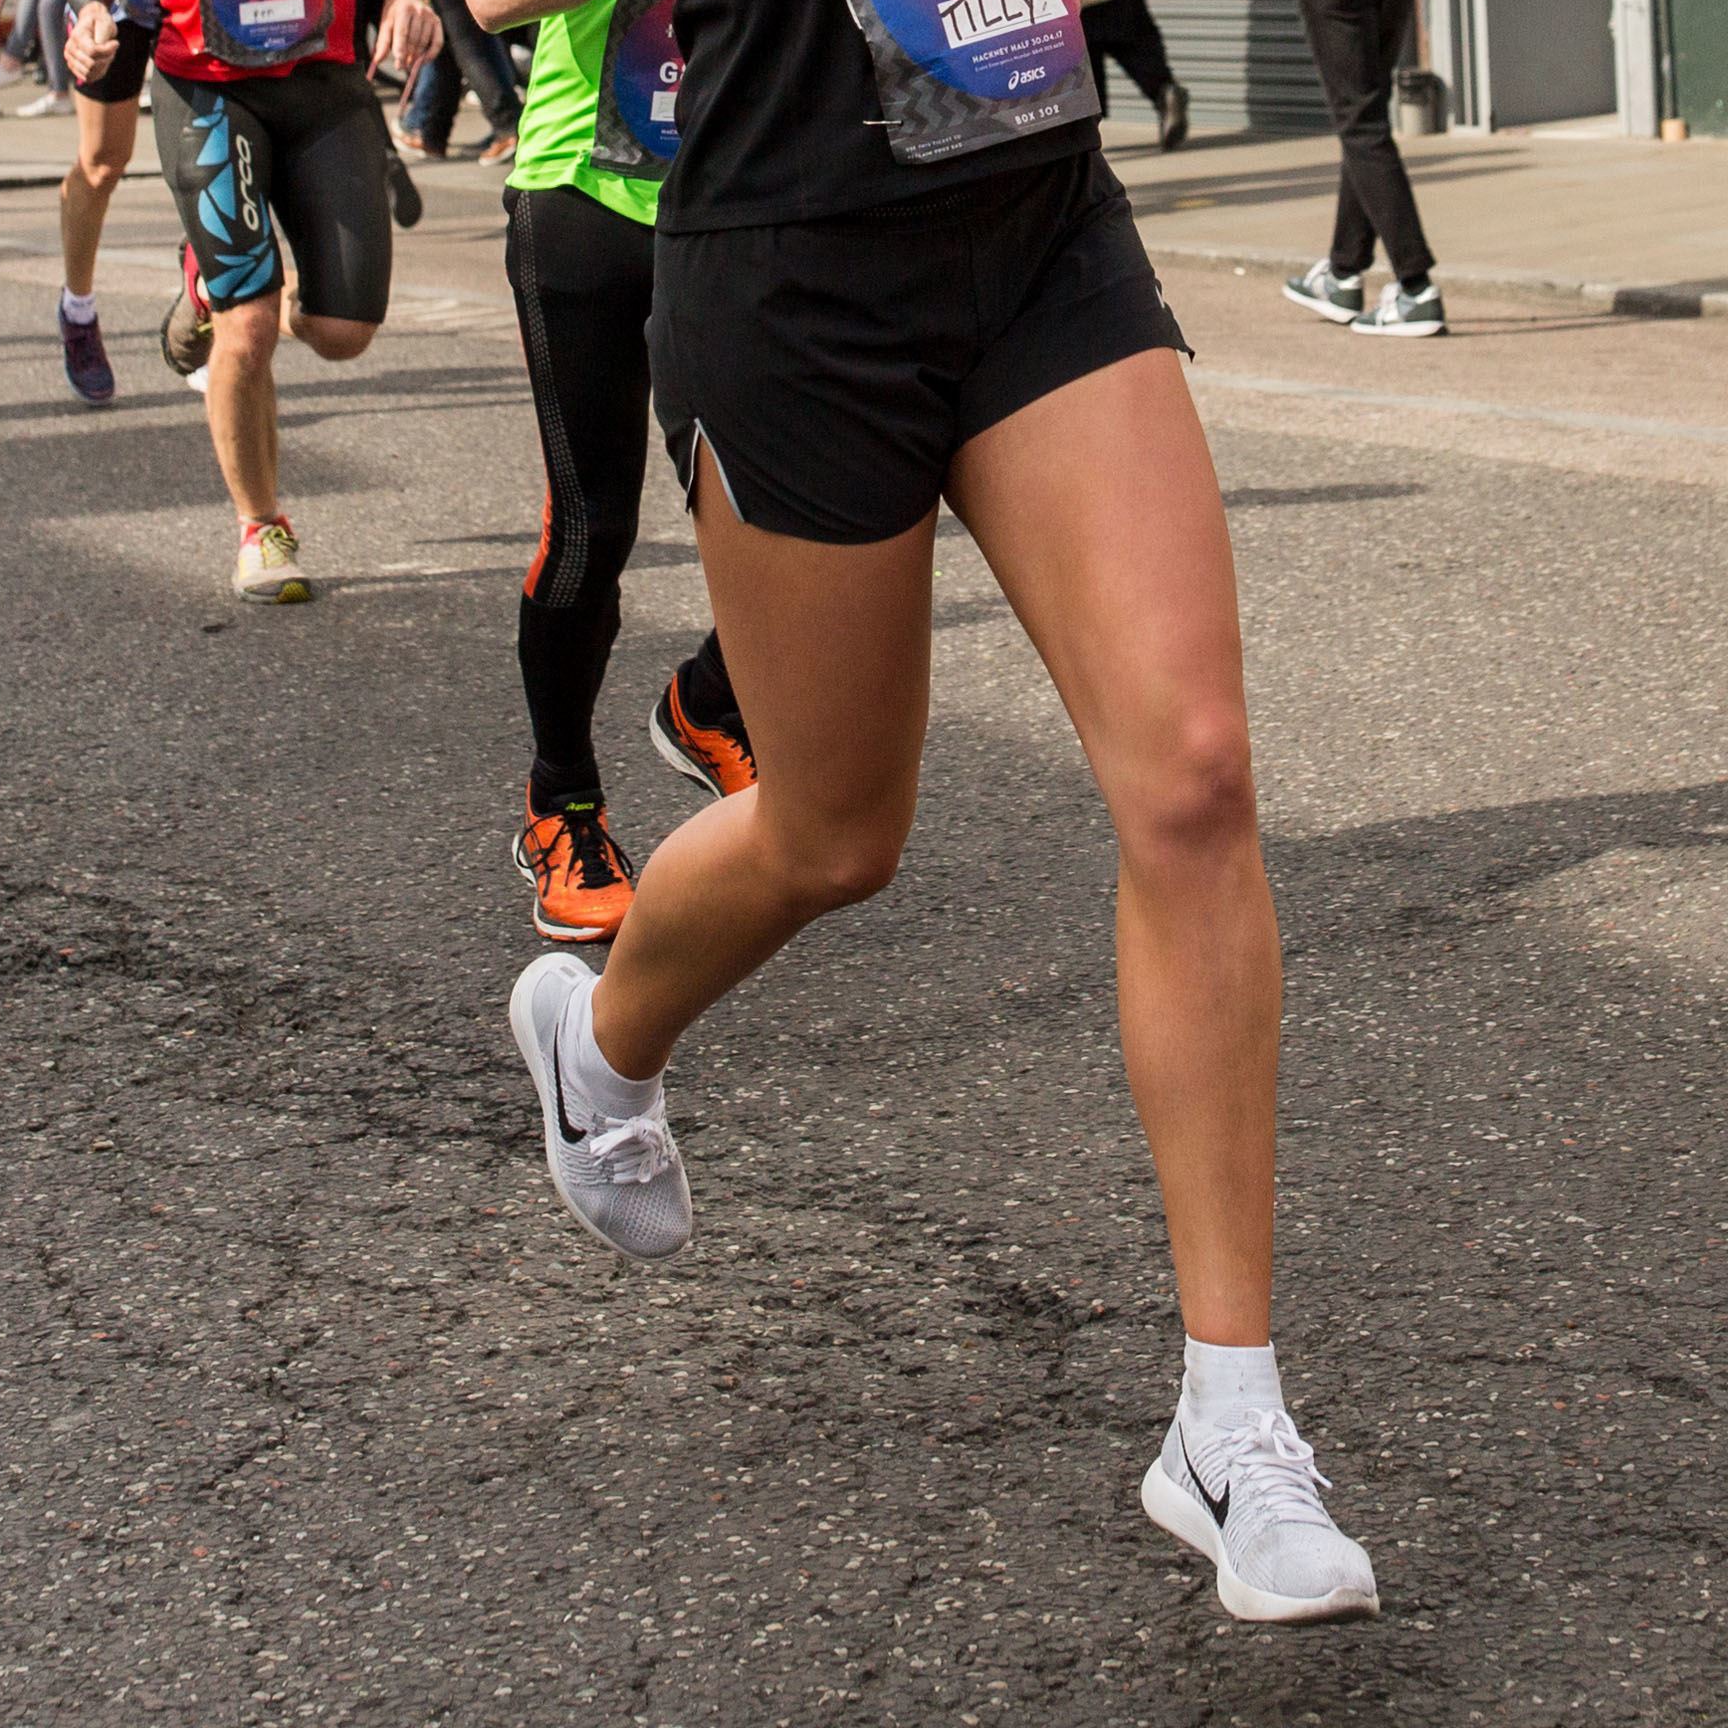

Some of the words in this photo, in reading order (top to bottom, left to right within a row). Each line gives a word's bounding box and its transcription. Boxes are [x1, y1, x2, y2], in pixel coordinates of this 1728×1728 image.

[972, 46, 1010, 65] HACKNEY
[1010, 39, 1030, 53] HALF
[1030, 30, 1064, 47] 30.04.17
[659, 60, 687, 84] G
[1020, 65, 1046, 84] asics
[1015, 111, 1036, 126] BOX
[1038, 103, 1060, 118] 302
